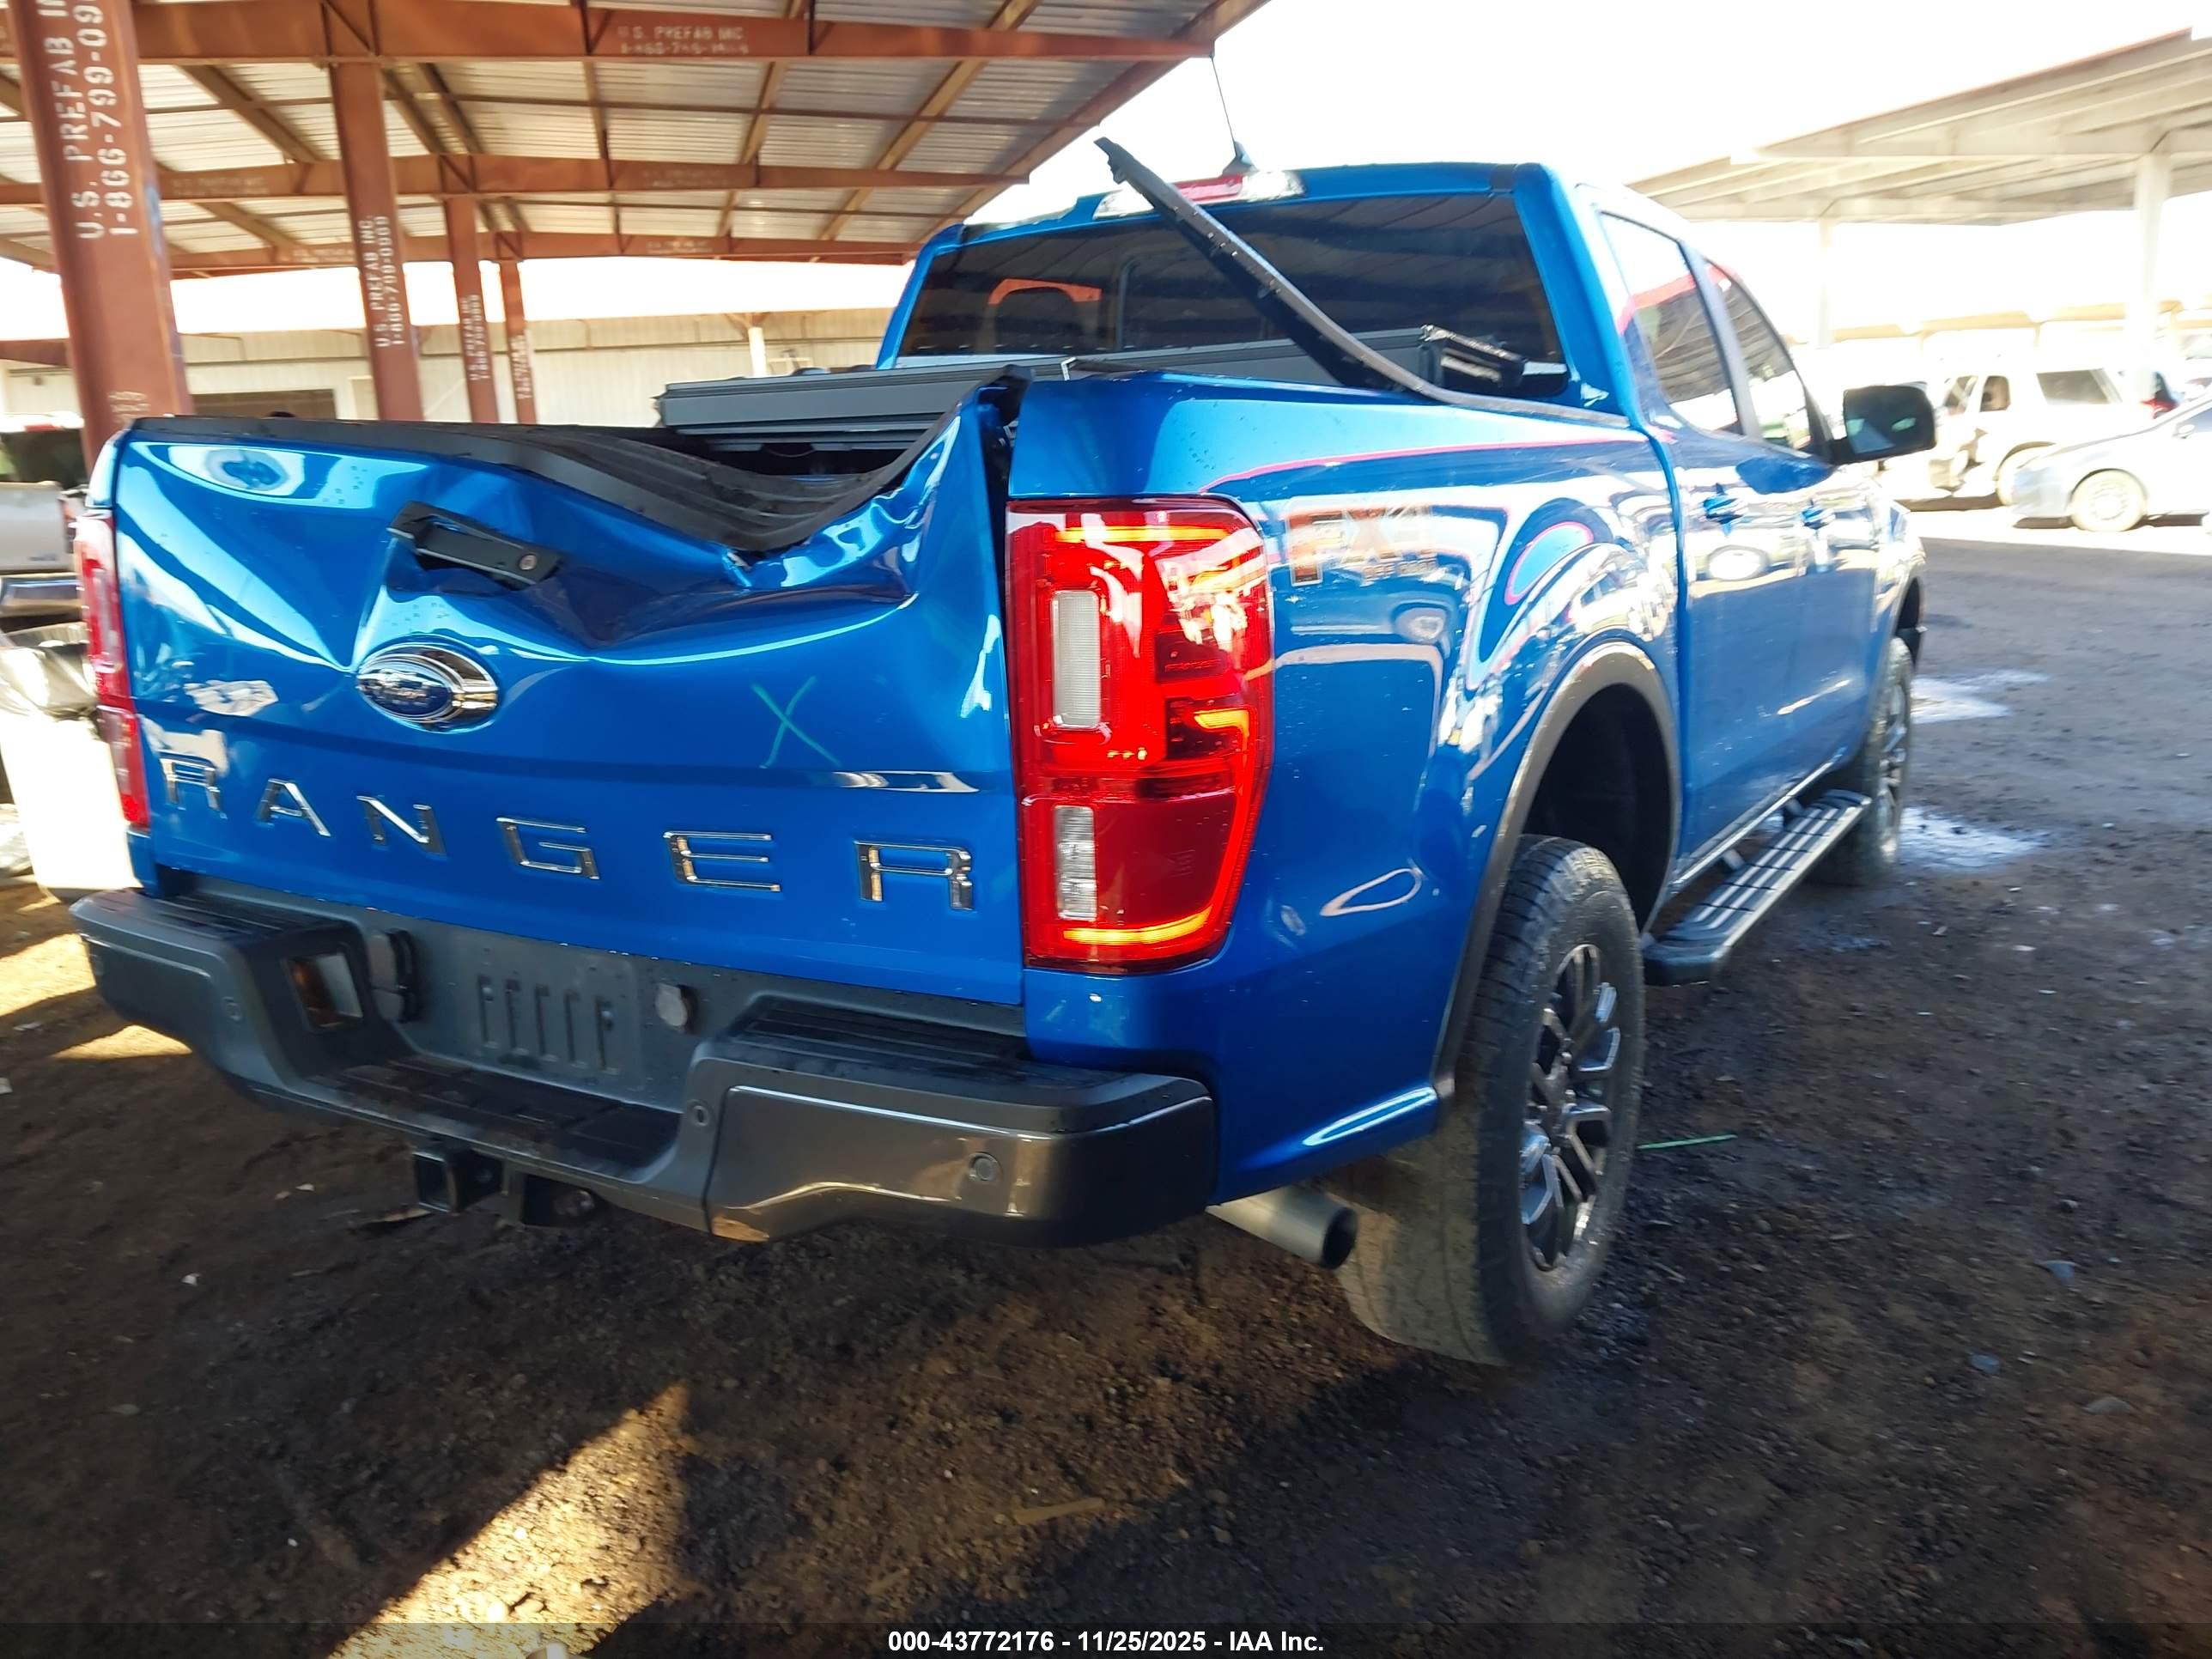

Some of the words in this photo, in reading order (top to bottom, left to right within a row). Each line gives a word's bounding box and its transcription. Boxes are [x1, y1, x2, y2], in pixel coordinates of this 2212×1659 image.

[44, 37, 94, 161] PREFAB
[72, 0, 138, 235] 1-866-799-09
[159, 749, 975, 910] RANGER
